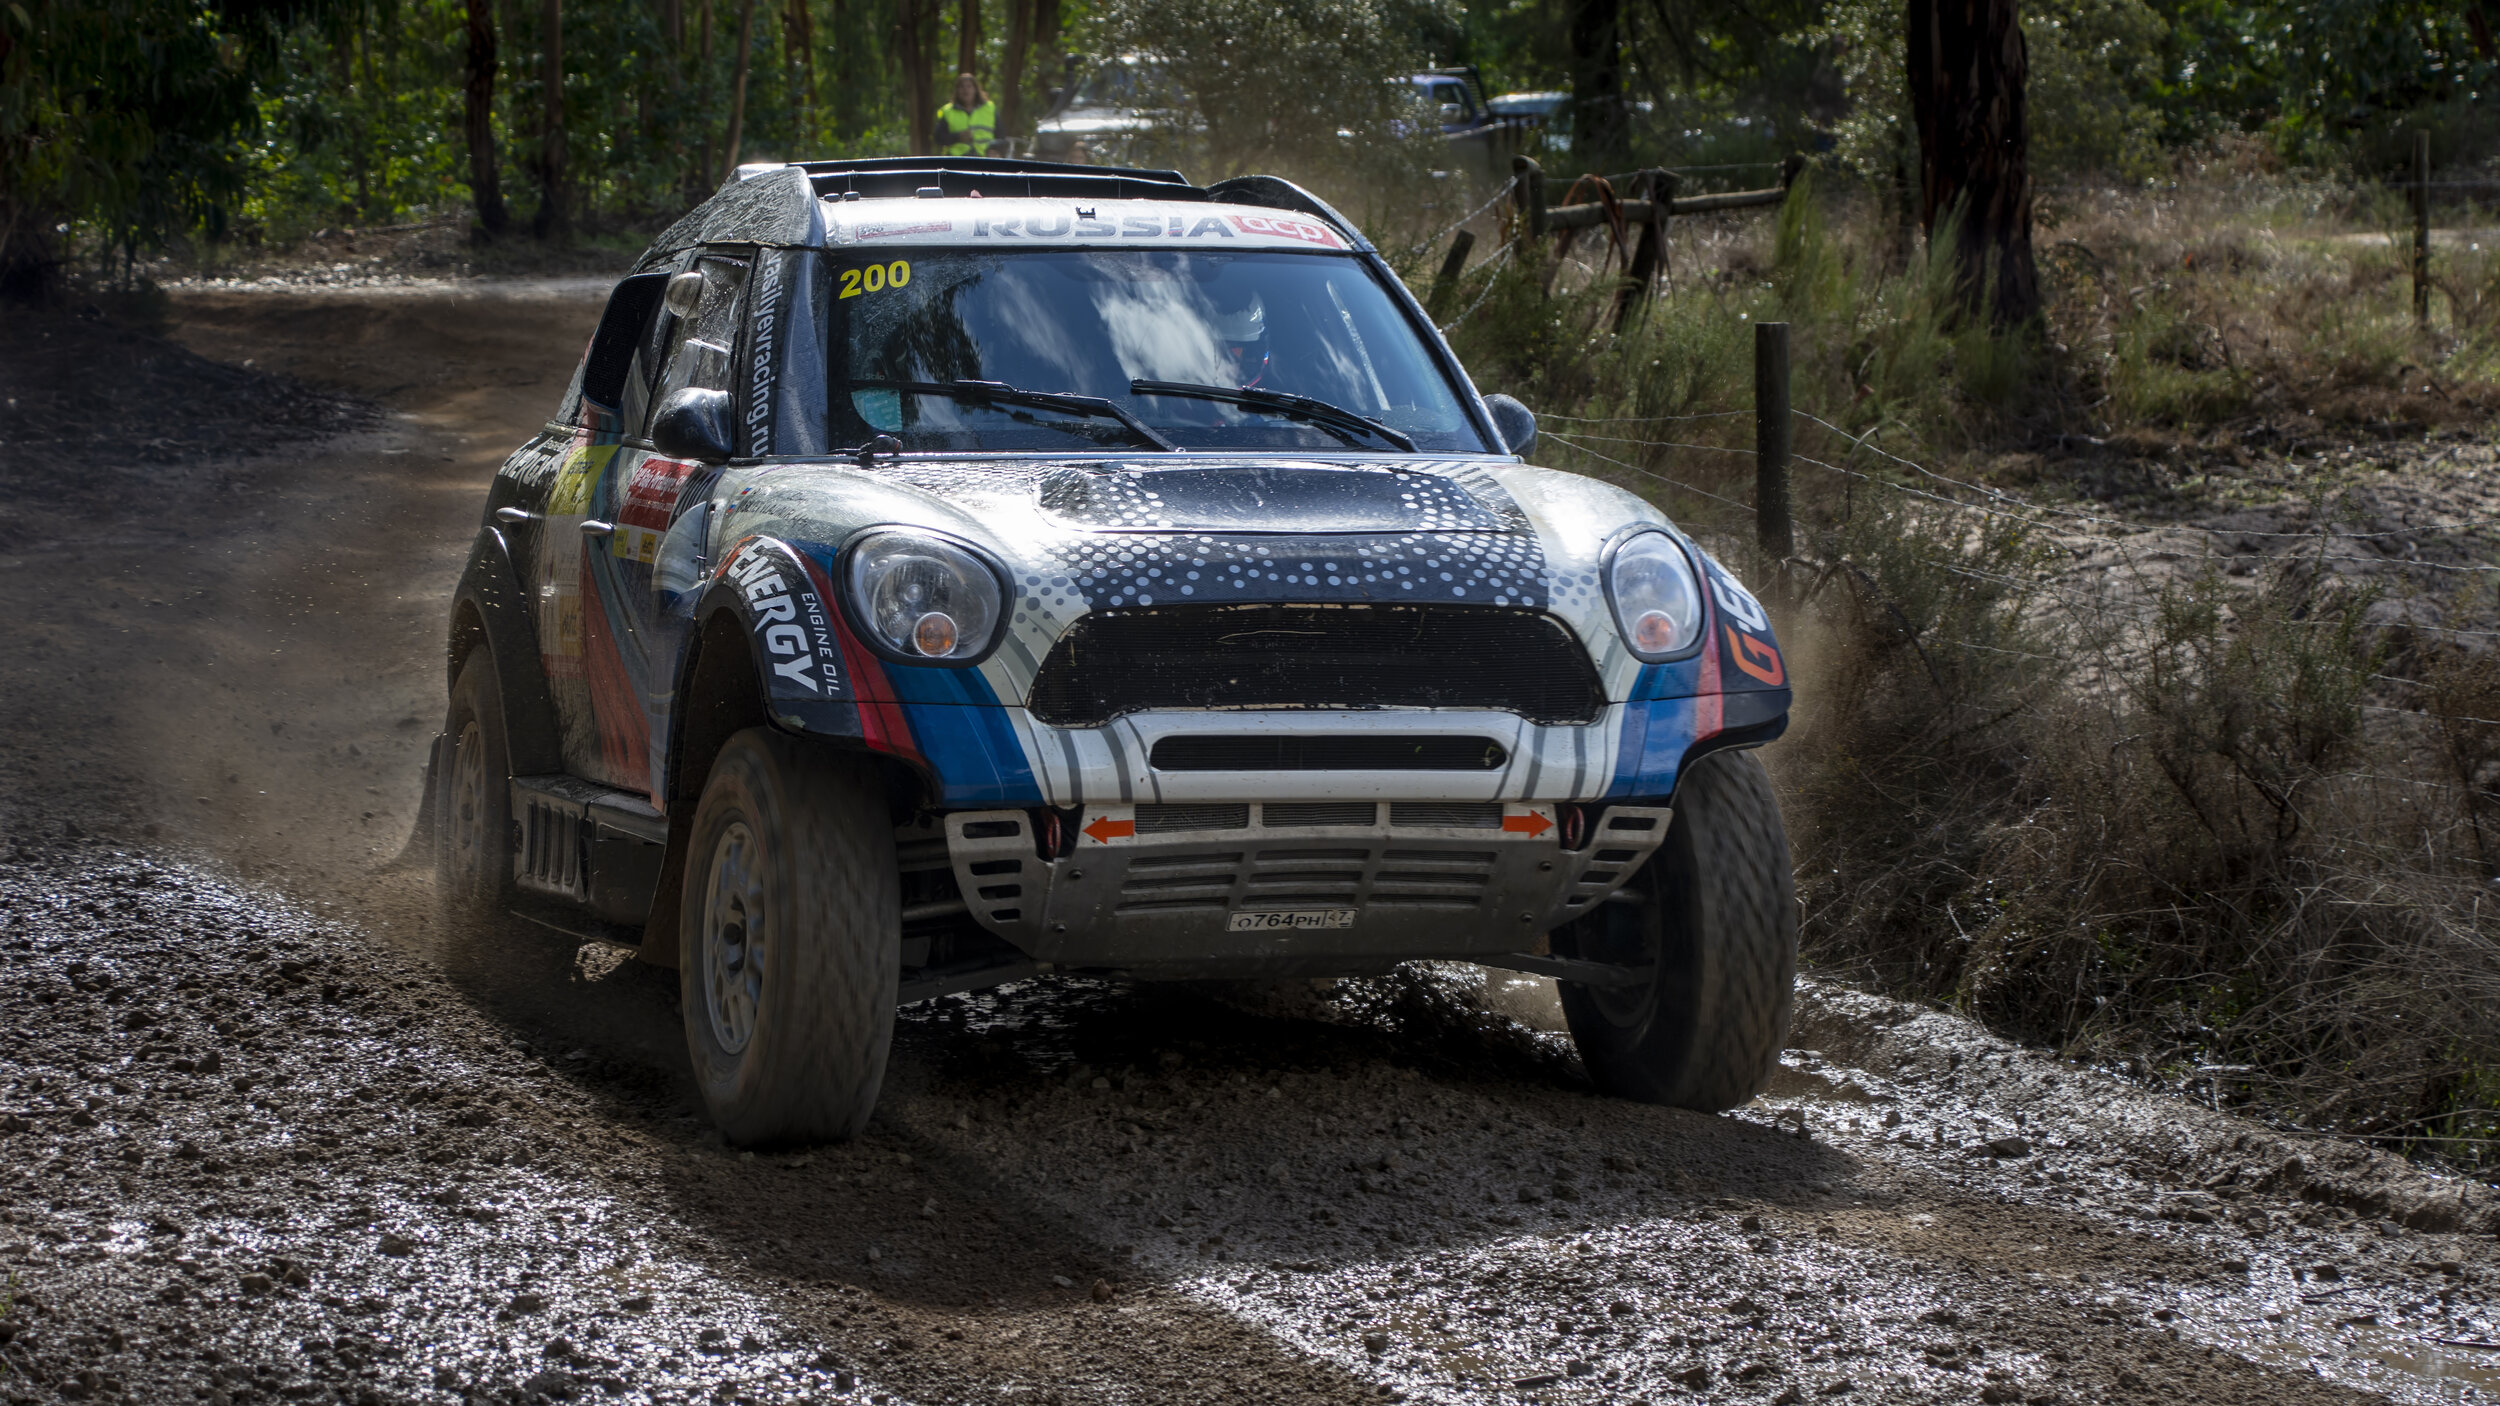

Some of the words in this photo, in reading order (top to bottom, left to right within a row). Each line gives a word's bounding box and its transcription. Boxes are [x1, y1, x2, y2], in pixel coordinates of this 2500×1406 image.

[971, 215, 1235, 238] RUSSIA
[838, 260, 910, 299] 200
[746, 250, 783, 458] vasilyevracing.ru
[801, 592, 834, 658] ENGINE
[823, 663, 840, 696] OIL
